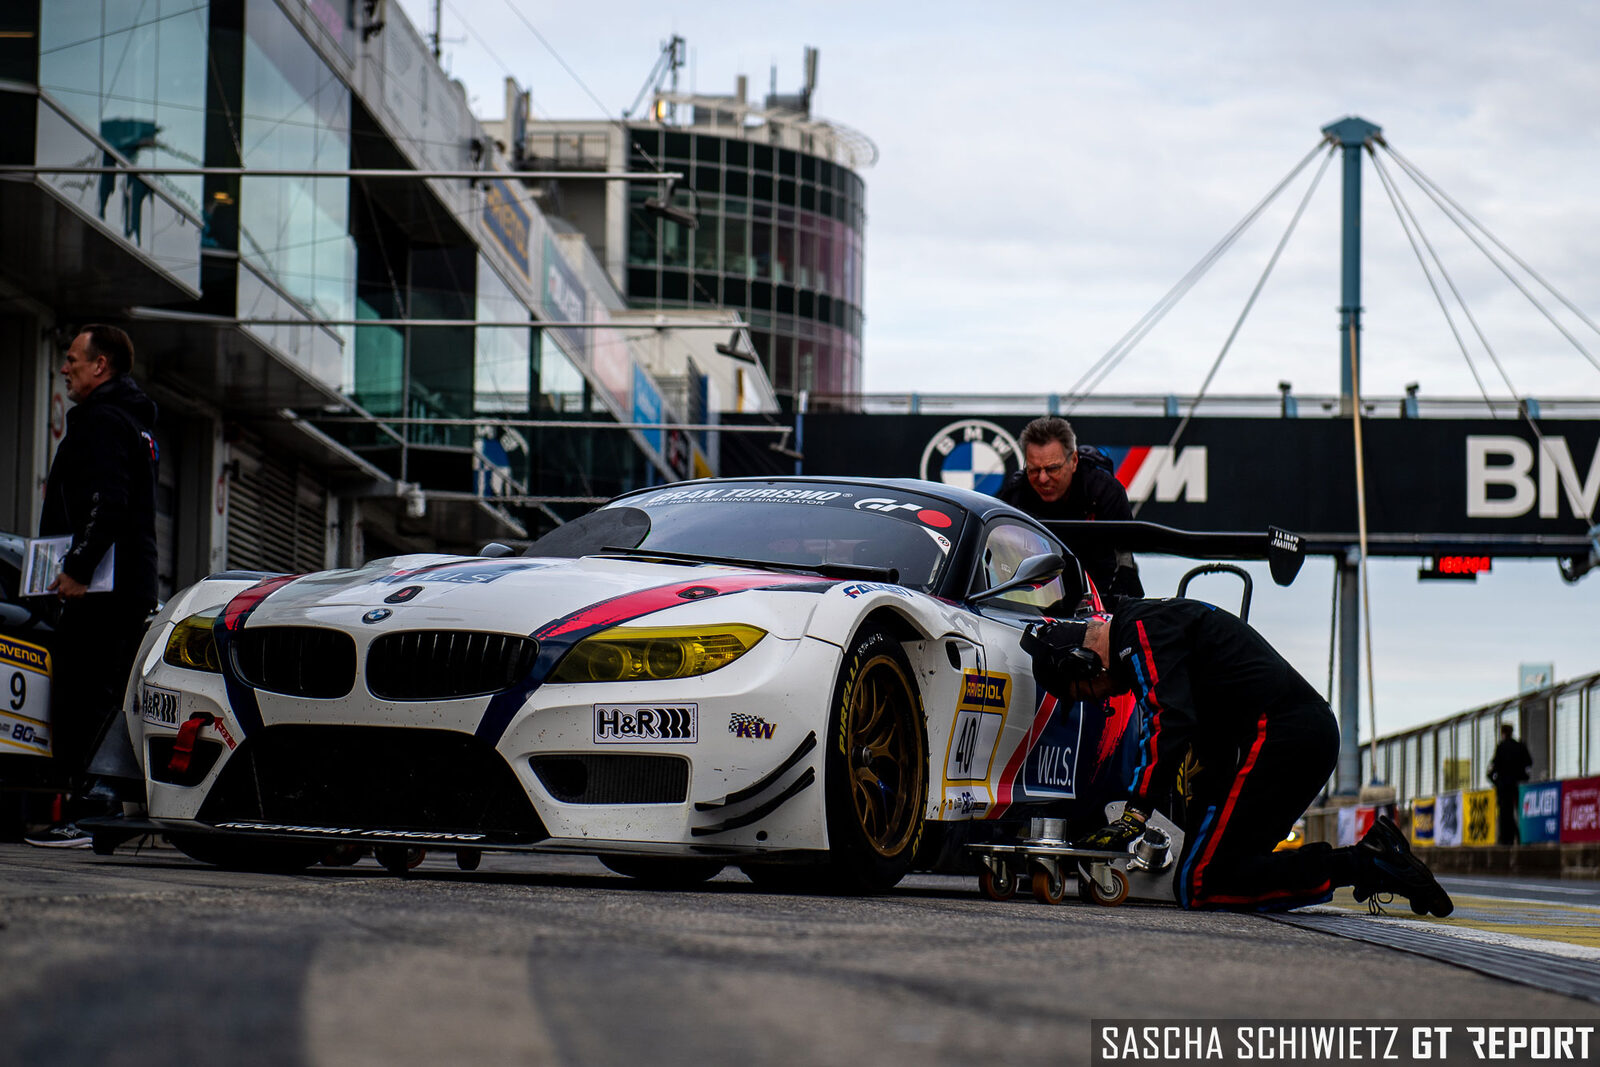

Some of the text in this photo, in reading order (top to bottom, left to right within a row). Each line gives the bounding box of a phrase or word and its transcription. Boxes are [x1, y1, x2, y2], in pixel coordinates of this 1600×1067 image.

[936, 426, 1012, 456] BMW
[649, 490, 727, 503] GRAN
[668, 498, 698, 506] REAL
[753, 497, 826, 506] SIMULATOR
[843, 583, 914, 600] FALKEN
[10, 671, 27, 711] 9
[839, 656, 859, 755] PIRELLI
[966, 681, 1002, 700] RAVENOL
[598, 708, 660, 738] H&R
[736, 720, 777, 740] KW
[956, 717, 977, 774] 40
[1038, 745, 1072, 786] W.I.S.
